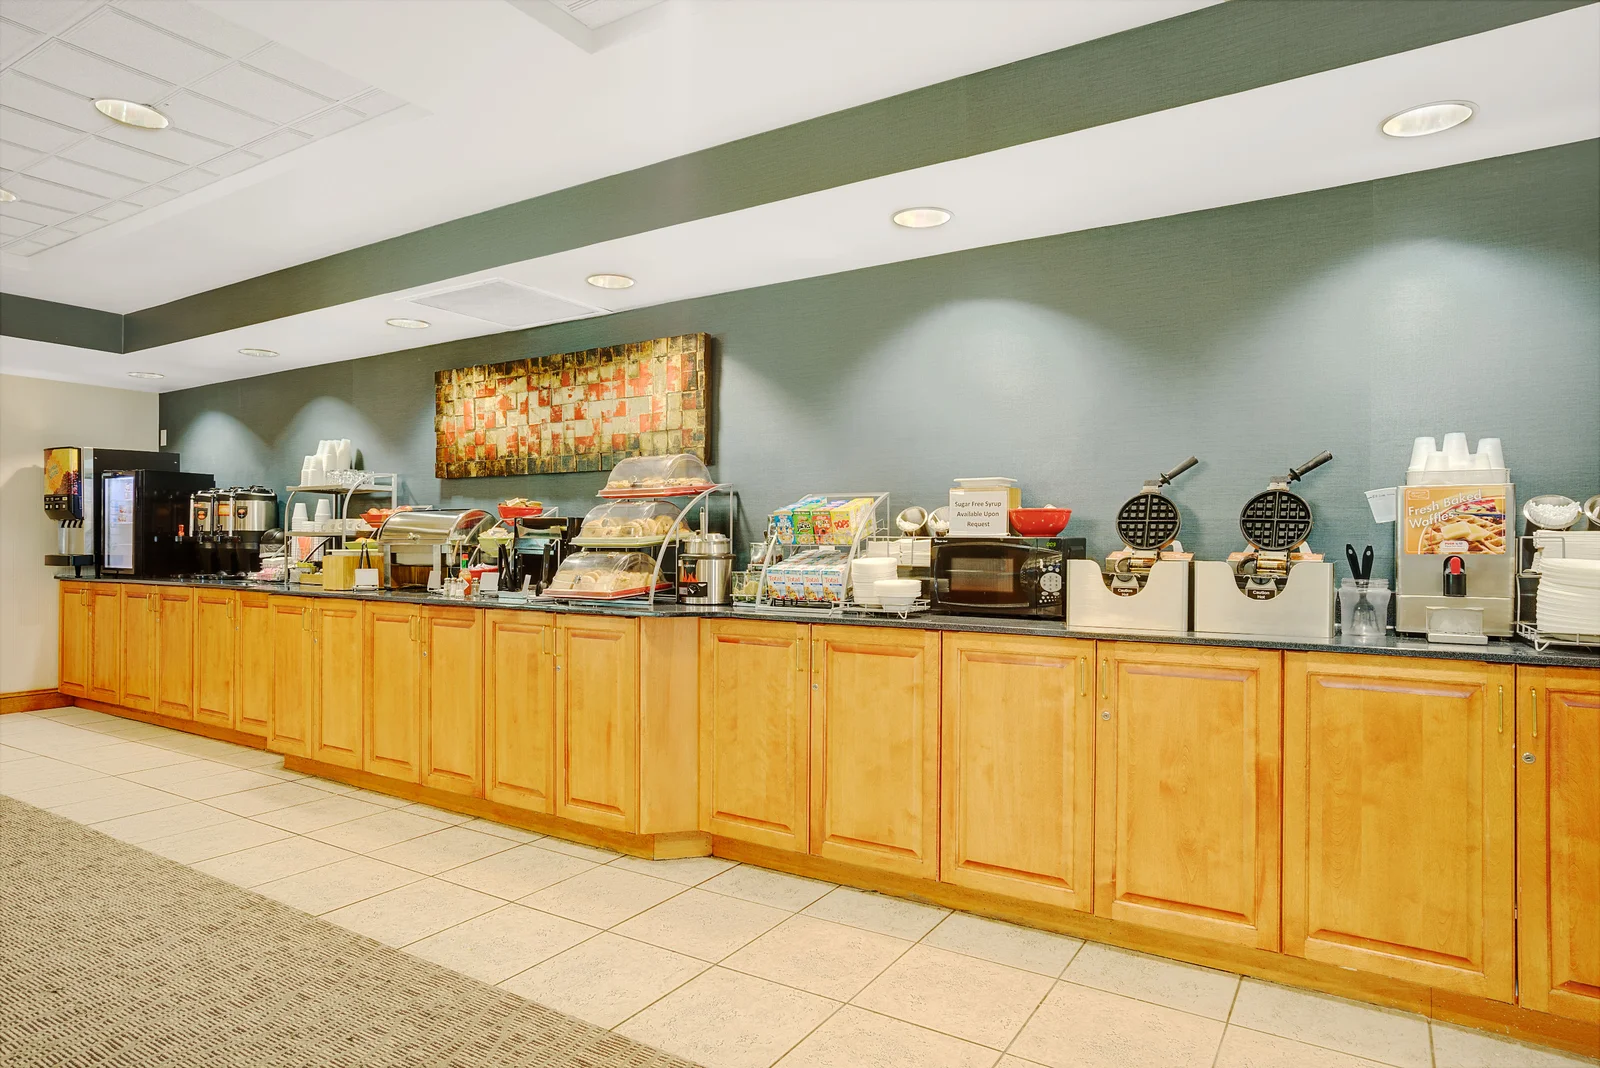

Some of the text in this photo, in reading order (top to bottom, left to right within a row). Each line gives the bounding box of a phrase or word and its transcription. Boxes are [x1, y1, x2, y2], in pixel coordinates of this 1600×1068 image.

[1408, 501, 1440, 516] Fresh
[1443, 488, 1482, 507] Baked
[1408, 511, 1455, 529] Waffles
